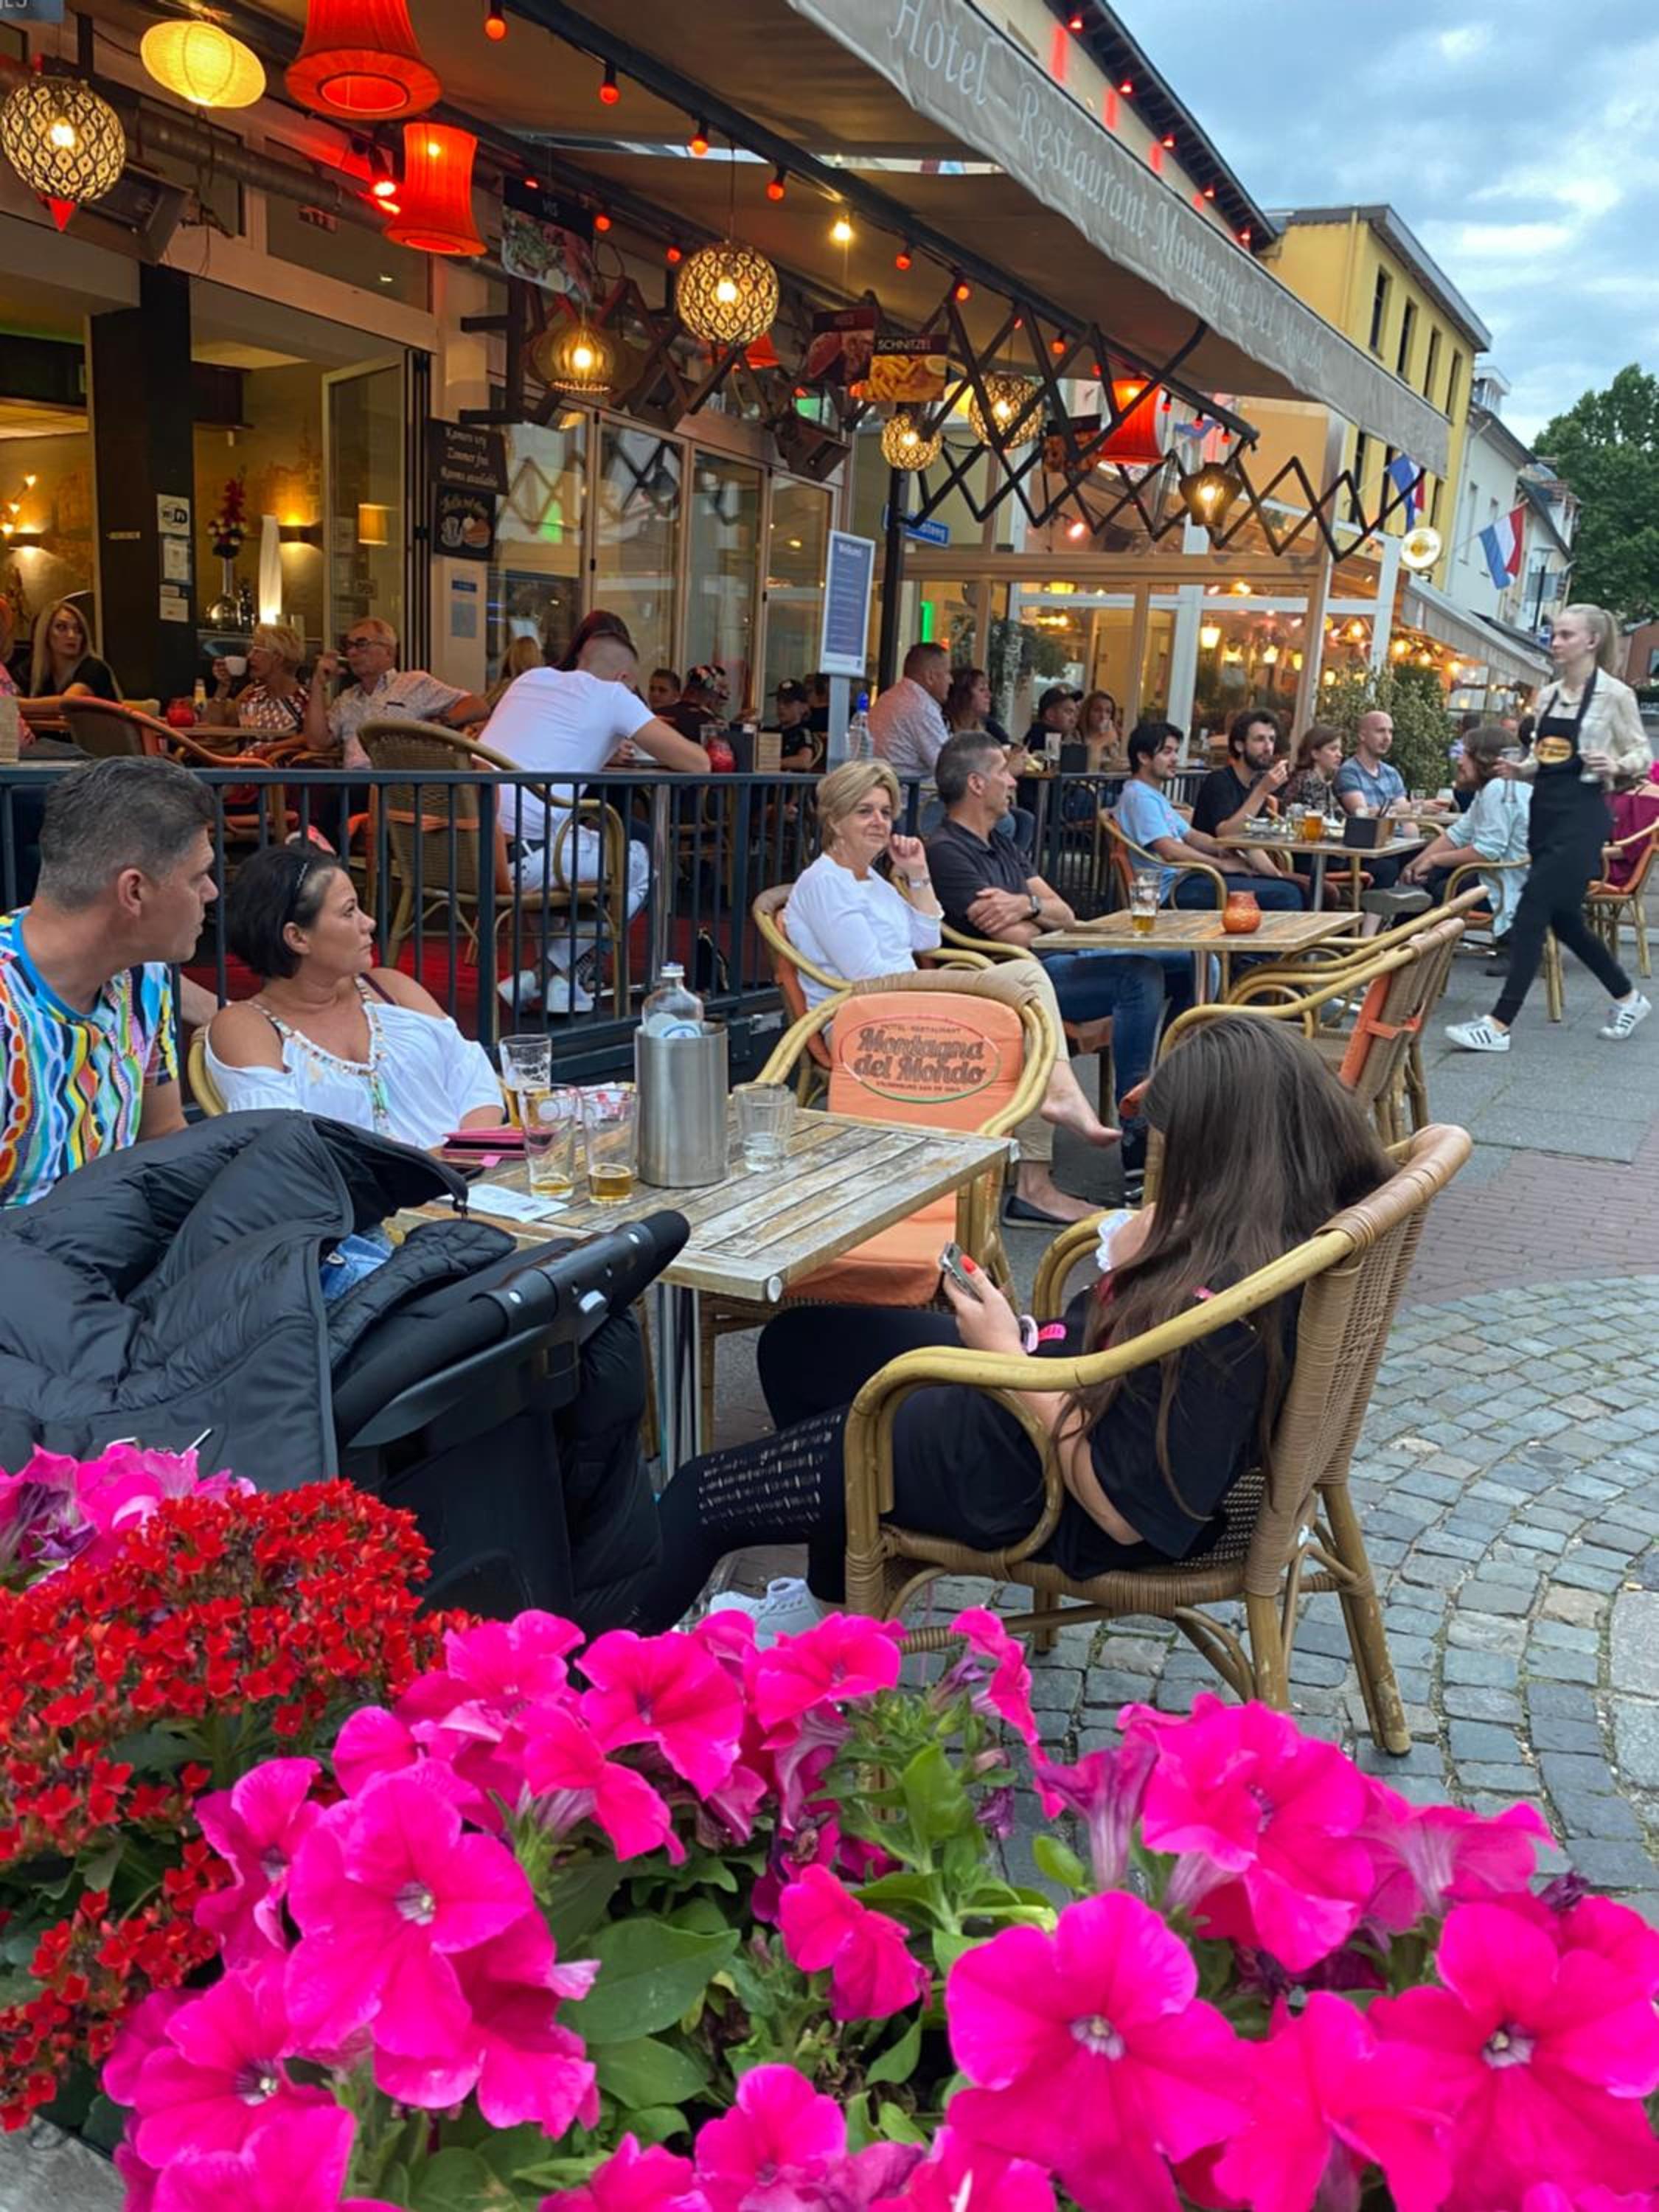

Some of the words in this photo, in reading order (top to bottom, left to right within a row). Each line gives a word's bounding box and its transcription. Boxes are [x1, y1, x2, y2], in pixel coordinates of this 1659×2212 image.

[887, 0, 988, 105] Hotel
[1017, 82, 1148, 237] Restaurant
[1152, 201, 1242, 319] Montagna
[877, 338, 931, 350] SCHNITZEL
[858, 1026, 985, 1064] Montagna
[854, 1054, 893, 1079] del
[897, 1055, 987, 1085] Mondo
